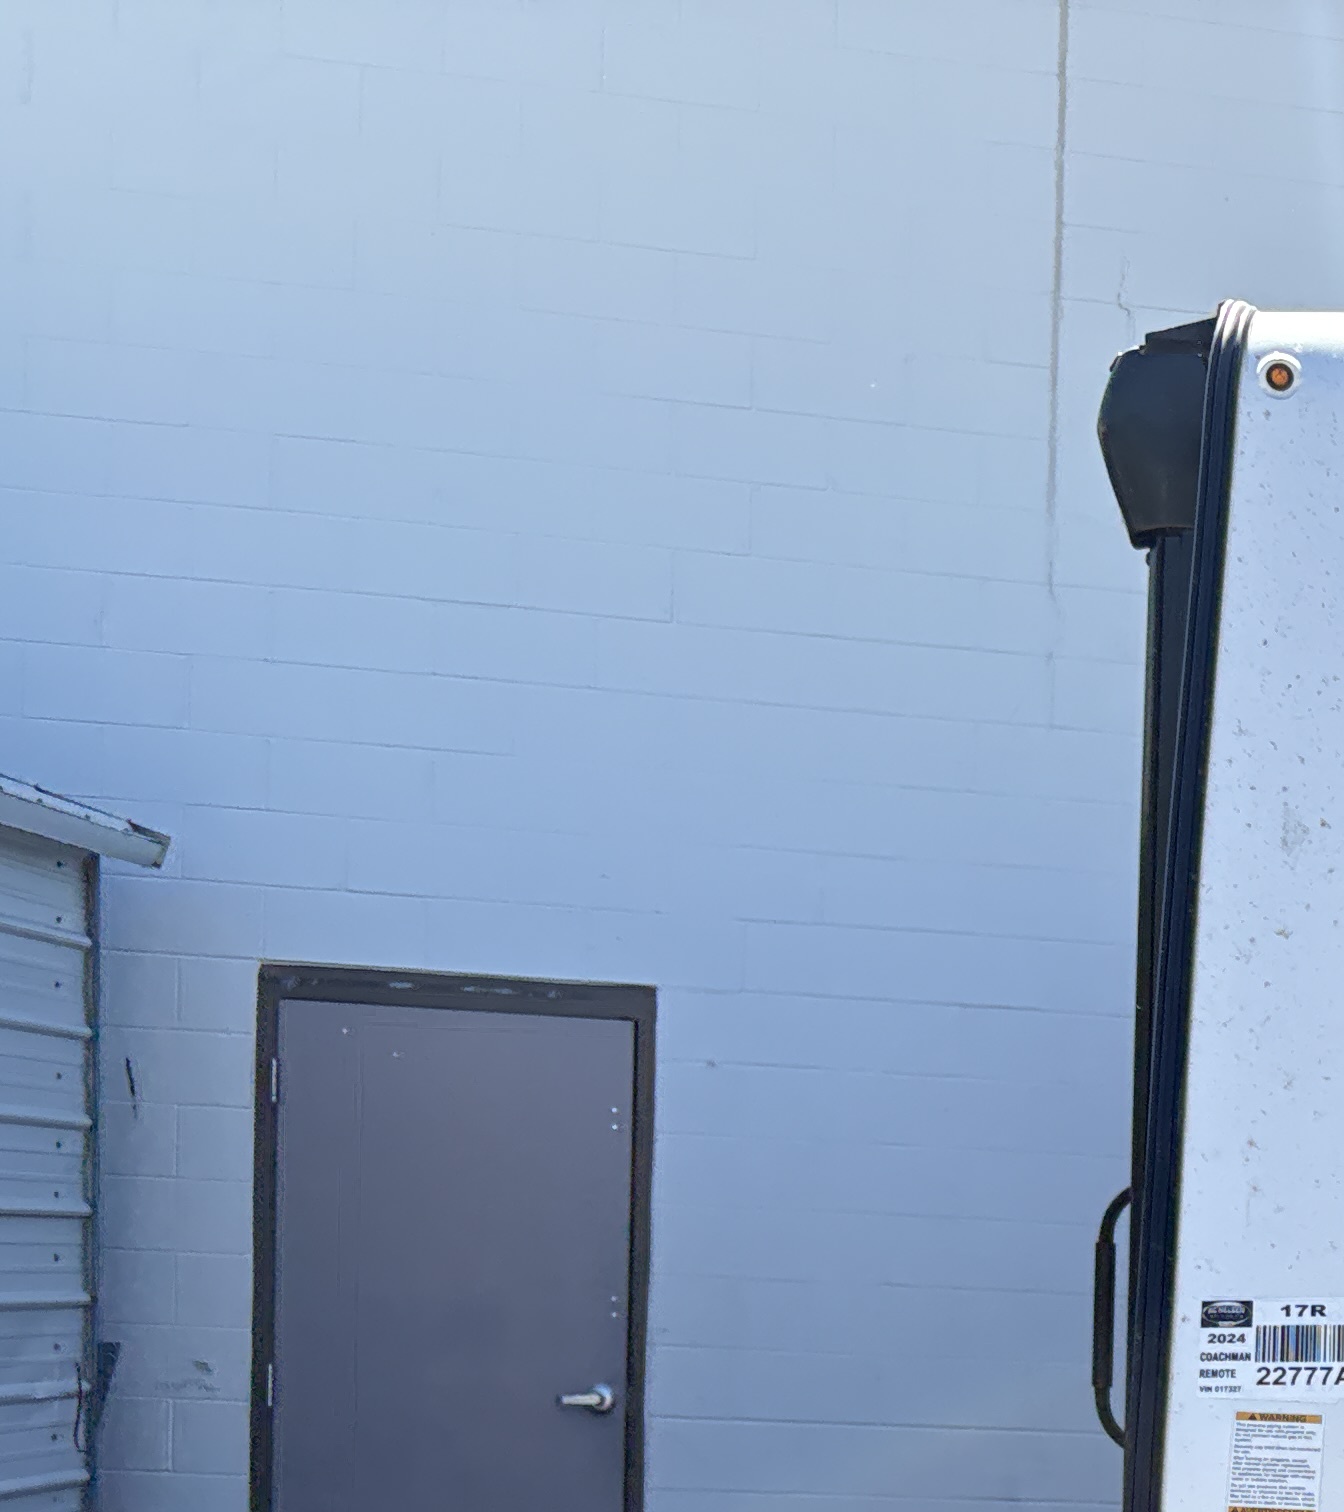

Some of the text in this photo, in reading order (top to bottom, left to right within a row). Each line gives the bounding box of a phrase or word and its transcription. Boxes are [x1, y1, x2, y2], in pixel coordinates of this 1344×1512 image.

[1280, 1304, 1327, 1317] 17R
[1207, 1333, 1247, 1344] 2024
[1199, 1352, 1251, 1362] COACHMAN
[1199, 1368, 1237, 1379] REMOTE
[1260, 1413, 1307, 1423] WARNING
